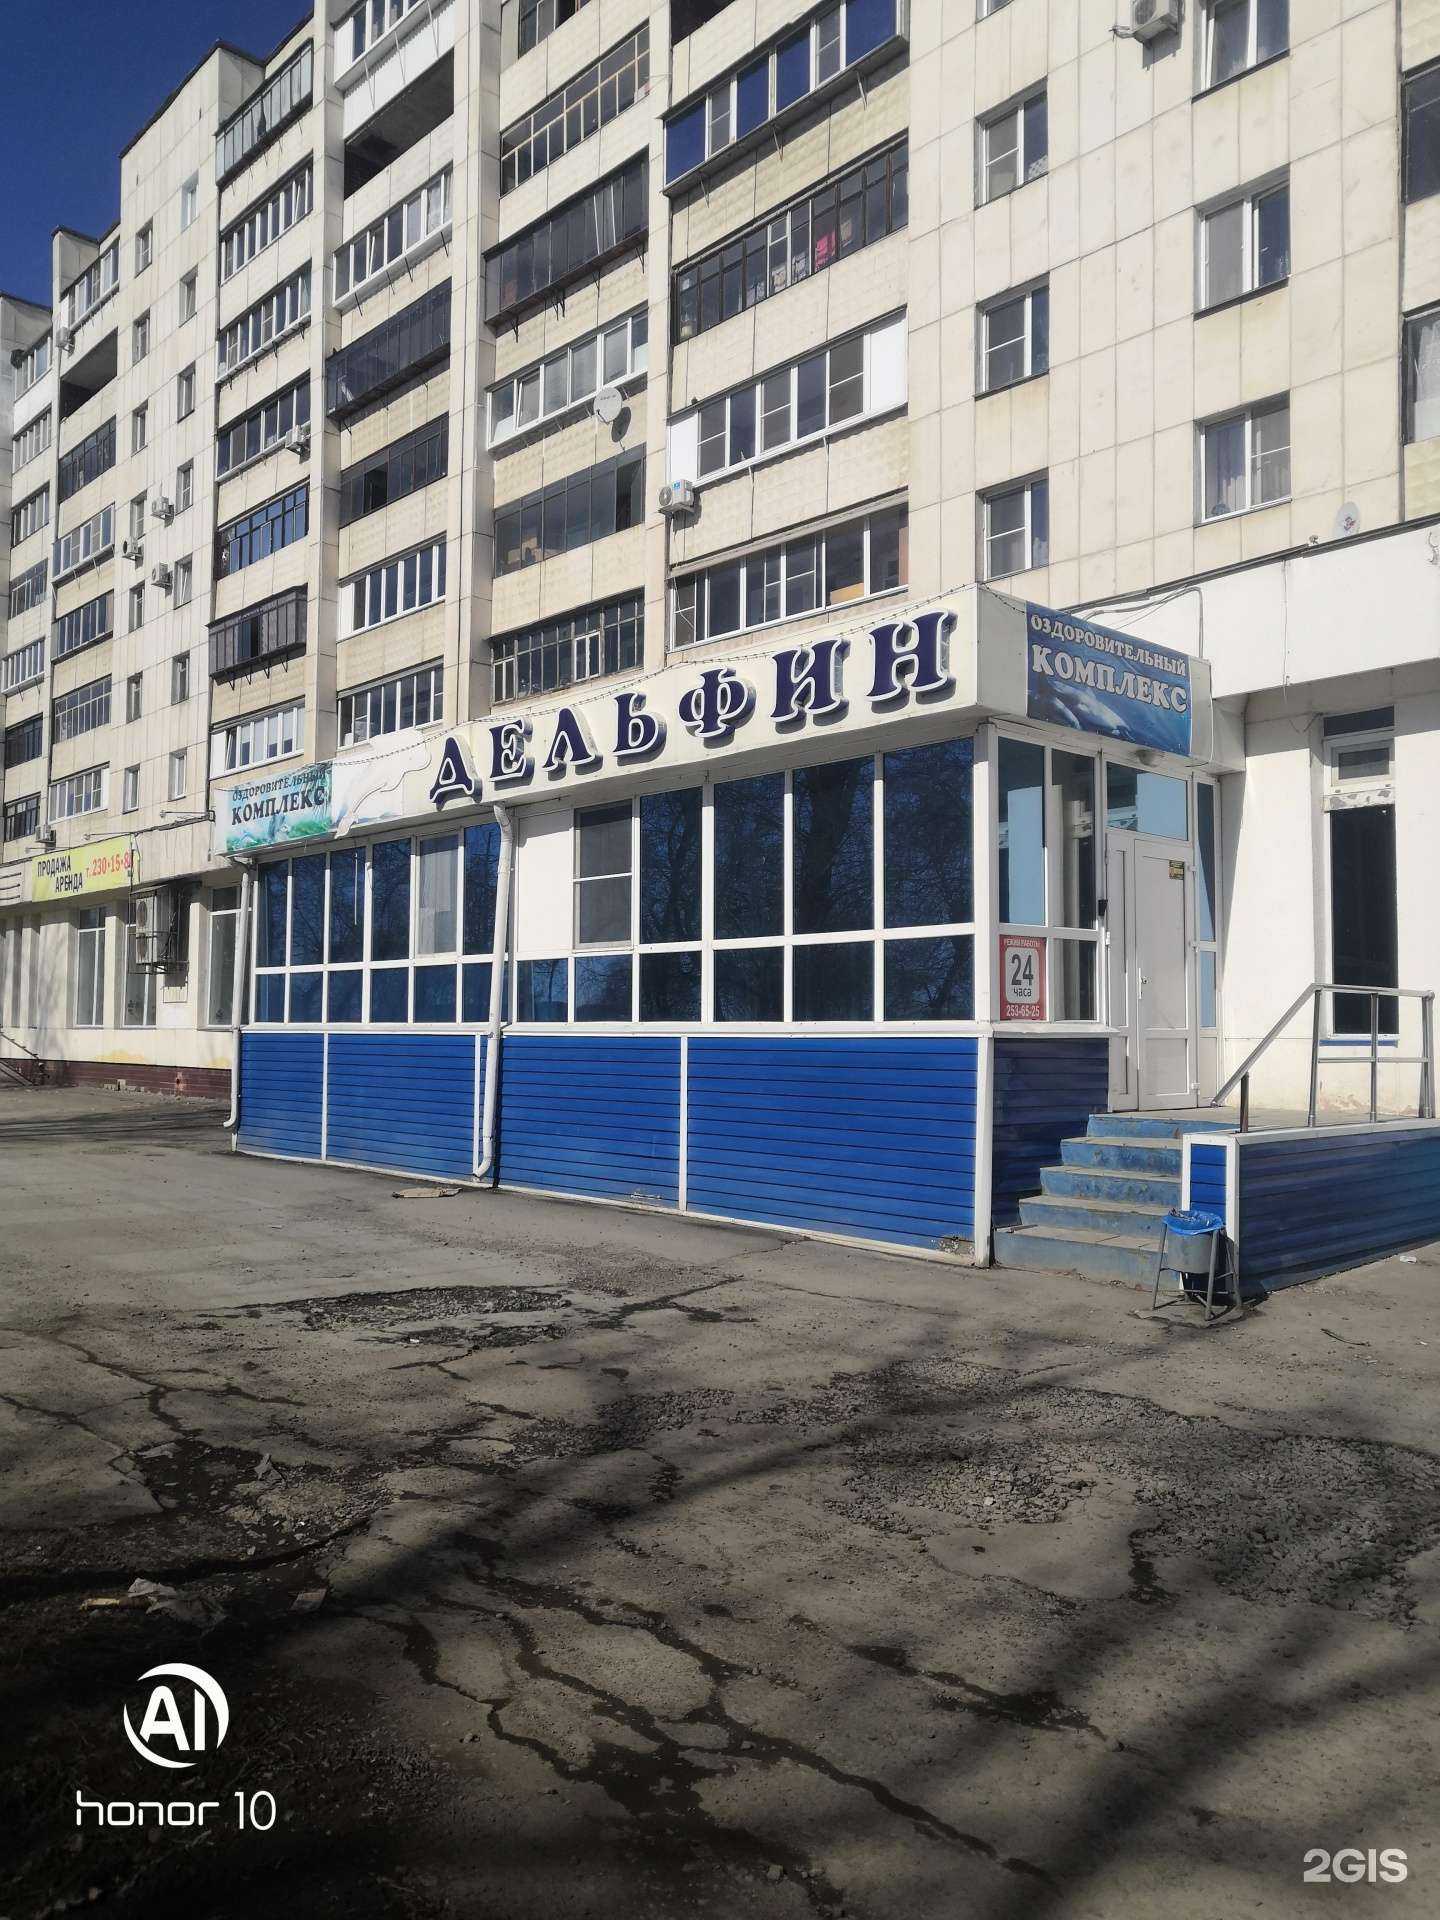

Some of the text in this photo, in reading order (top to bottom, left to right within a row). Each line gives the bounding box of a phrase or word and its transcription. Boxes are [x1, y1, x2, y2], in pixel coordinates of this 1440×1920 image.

[1030, 614, 1186, 676] ОЗДОРОВИТЕЛЬНЫЙ
[1031, 644, 1187, 714] КОМПЛЕКС
[429, 608, 957, 807] ДЕЛЬФИН
[232, 768, 326, 802] ОЗДОРОВИТЕЛЬНЫЙ
[231, 786, 325, 826] КОМПЛЕКС
[37, 855, 71, 878] ПРОДАЖА
[55, 872, 83, 893] АРЕНДА
[1011, 953, 1034, 986] 24
[1013, 987, 1032, 997] часа
[1006, 1004, 1040, 1017] 253-65-25
